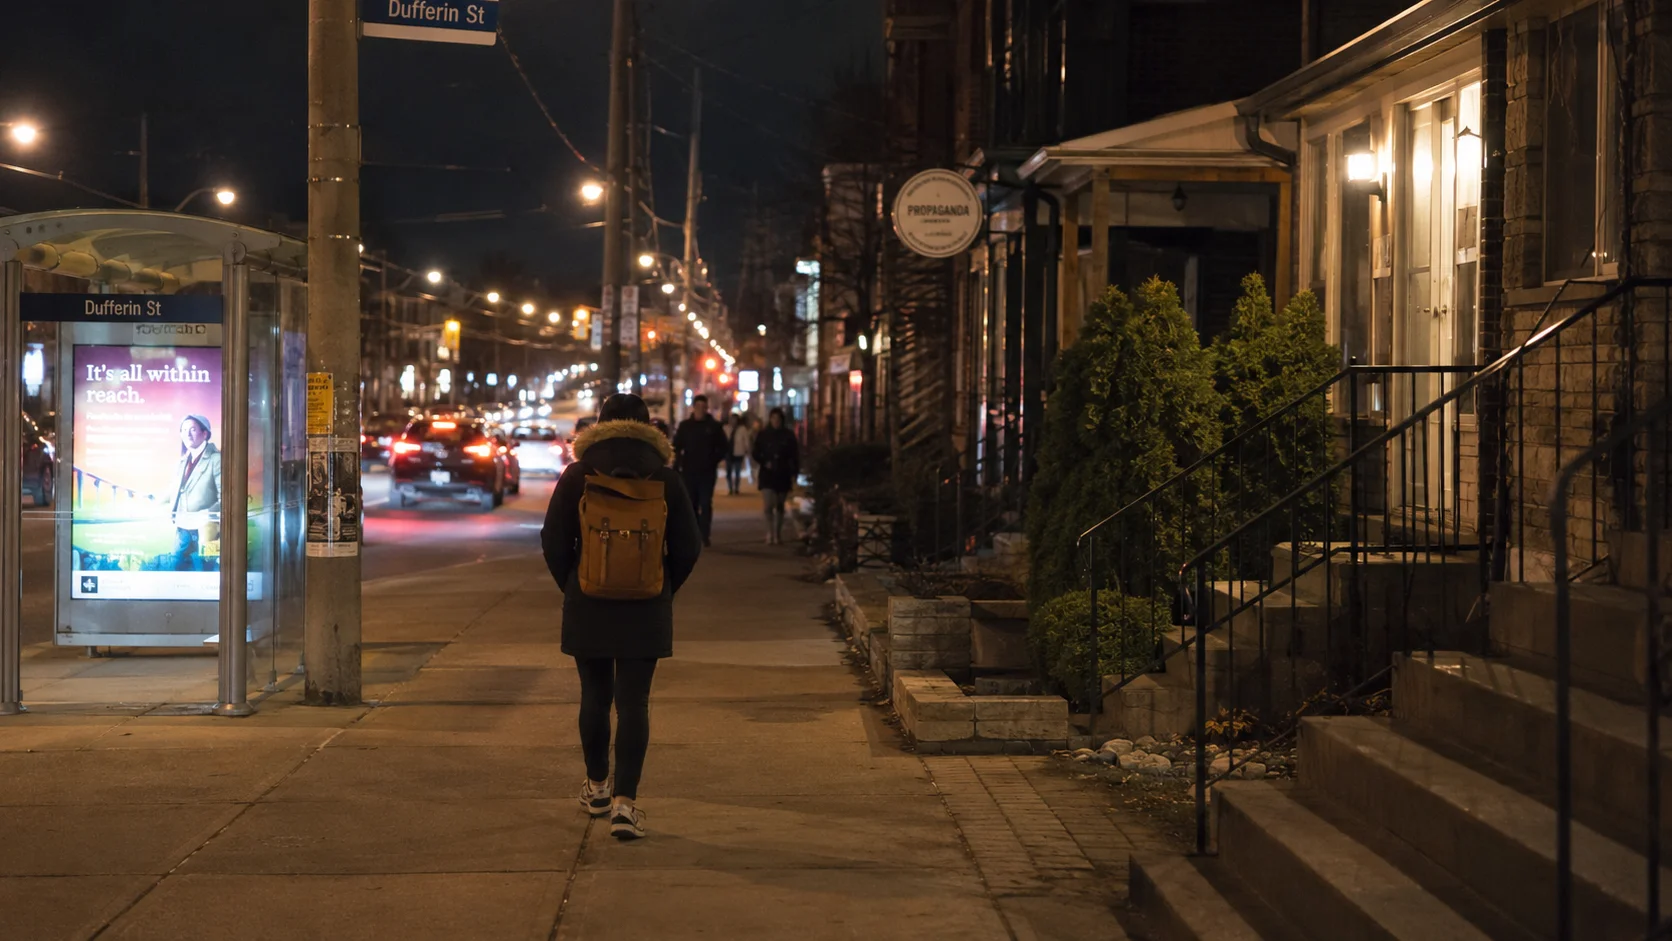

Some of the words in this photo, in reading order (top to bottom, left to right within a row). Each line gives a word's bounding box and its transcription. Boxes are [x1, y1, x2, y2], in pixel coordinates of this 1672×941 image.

[388, 0, 459, 22] Dufferin
[466, 4, 485, 24] St
[907, 204, 970, 216] PROPAGANDA
[85, 300, 141, 316] Dufferin
[146, 301, 162, 316] St
[86, 364, 114, 381] It's
[119, 364, 143, 382] all
[146, 365, 211, 383] within
[86, 386, 146, 404] reach.
